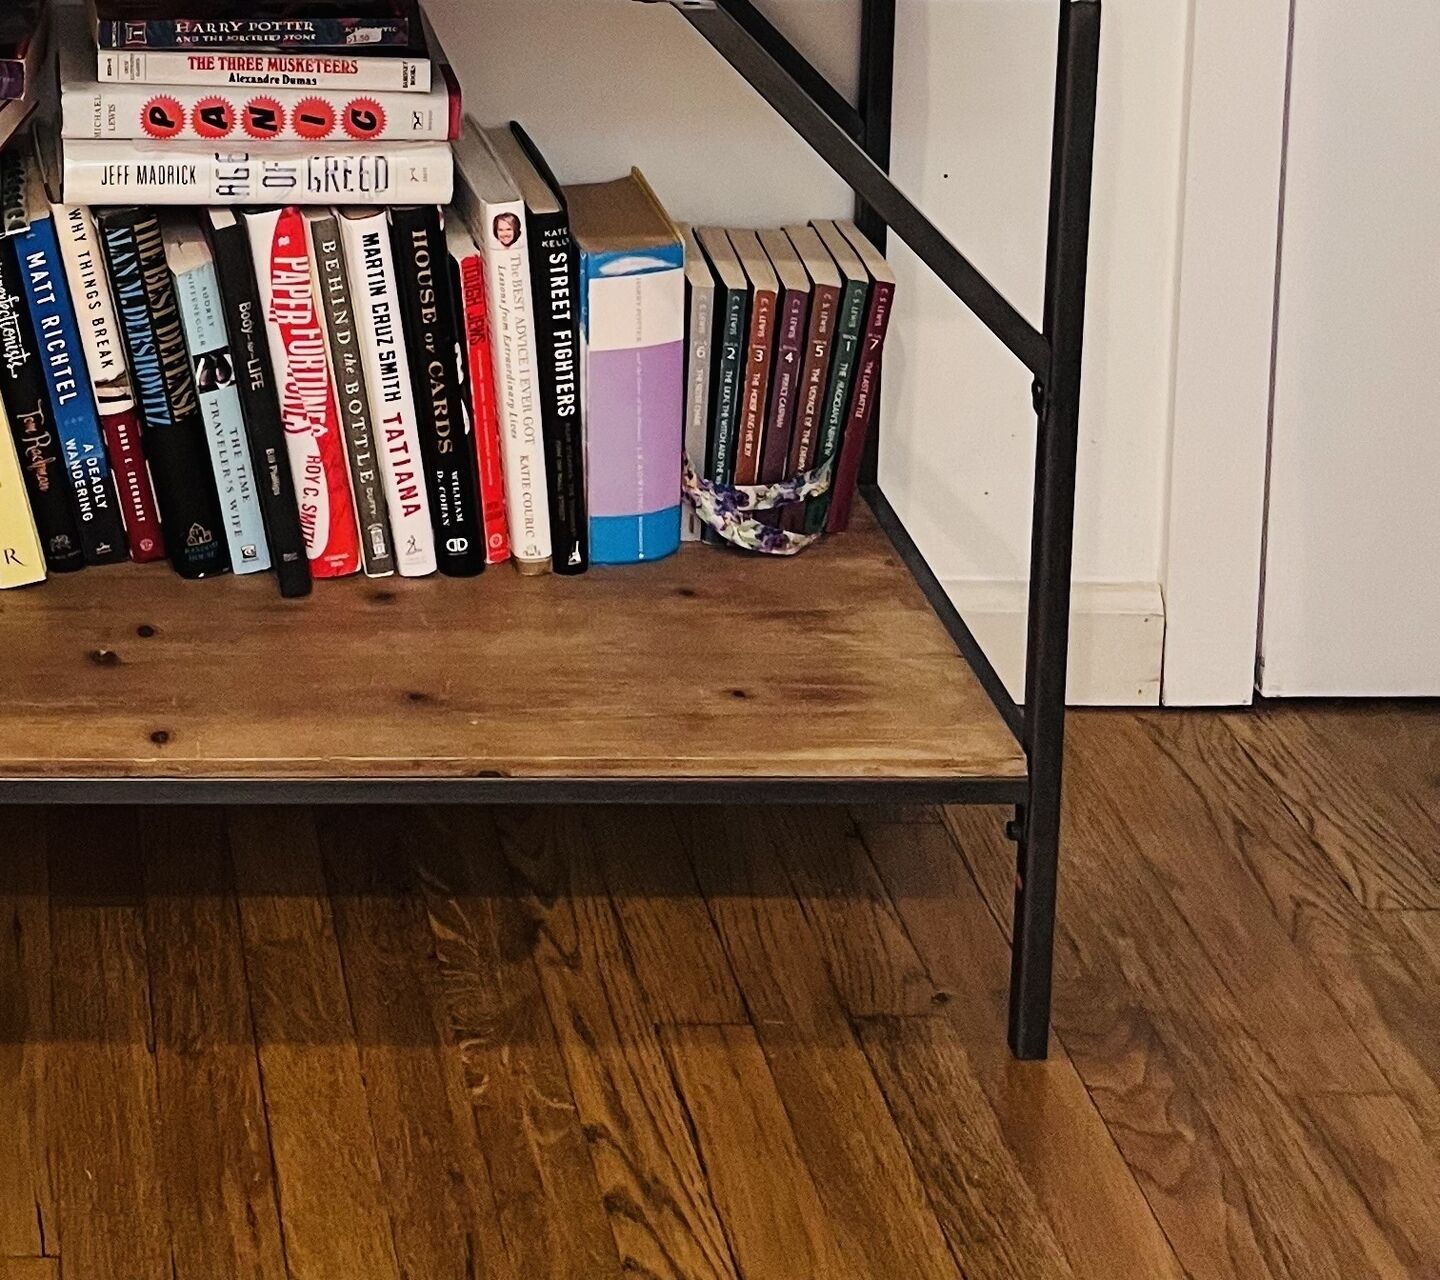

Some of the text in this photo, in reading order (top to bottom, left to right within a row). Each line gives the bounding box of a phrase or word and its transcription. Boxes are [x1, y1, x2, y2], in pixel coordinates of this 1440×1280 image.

[174, 21, 314, 33] HARRY POTTER
[187, 56, 358, 73] THE THREE MUSKETEERS
[228, 72, 317, 85] Alexandre Dumas
[107, 104, 116, 131] LEWIS
[101, 165, 197, 186] JEFF MADRICK
[307, 155, 389, 193] GREED
[544, 227, 568, 237] KATE
[508, 254, 522, 276] The
[546, 251, 572, 321] STREET
[67, 207, 115, 369] WHY THINGS BREAK
[509, 278, 525, 313] BEST
[25, 250, 78, 406] MATT RICHTEL
[361, 232, 401, 403] MARTIN CRUZ SMITH
[497, 304, 512, 331] from
[260, 252, 336, 441] PAPER FORTUNES
[320, 239, 374, 484] BEHIND the BOTTLE
[409, 228, 455, 454] HOUSE CARDS
[512, 316, 530, 365] ADVICE
[696, 345, 706, 358] 6
[726, 347, 735, 360] 2
[753, 348, 763, 362] 3
[783, 351, 794, 363] 4
[814, 344, 824, 357] 5
[868, 338, 879, 351] 7
[122, 304, 173, 429] DERSHOWITZ
[550, 329, 578, 417] FIGHTERS
[517, 377, 532, 413] EVER
[521, 416, 535, 445] GOT
[64, 437, 94, 522] WANDERING
[82, 442, 107, 510] A DEADLY
[207, 399, 242, 537] TRAVELER'S WIFE
[229, 426, 251, 504] THE TIME
[381, 411, 421, 519] TATIANA
[297, 454, 324, 550] ROY C. SMITH
[448, 470, 465, 523] WILLIAM
[517, 454, 536, 538] KATIE COURIC
